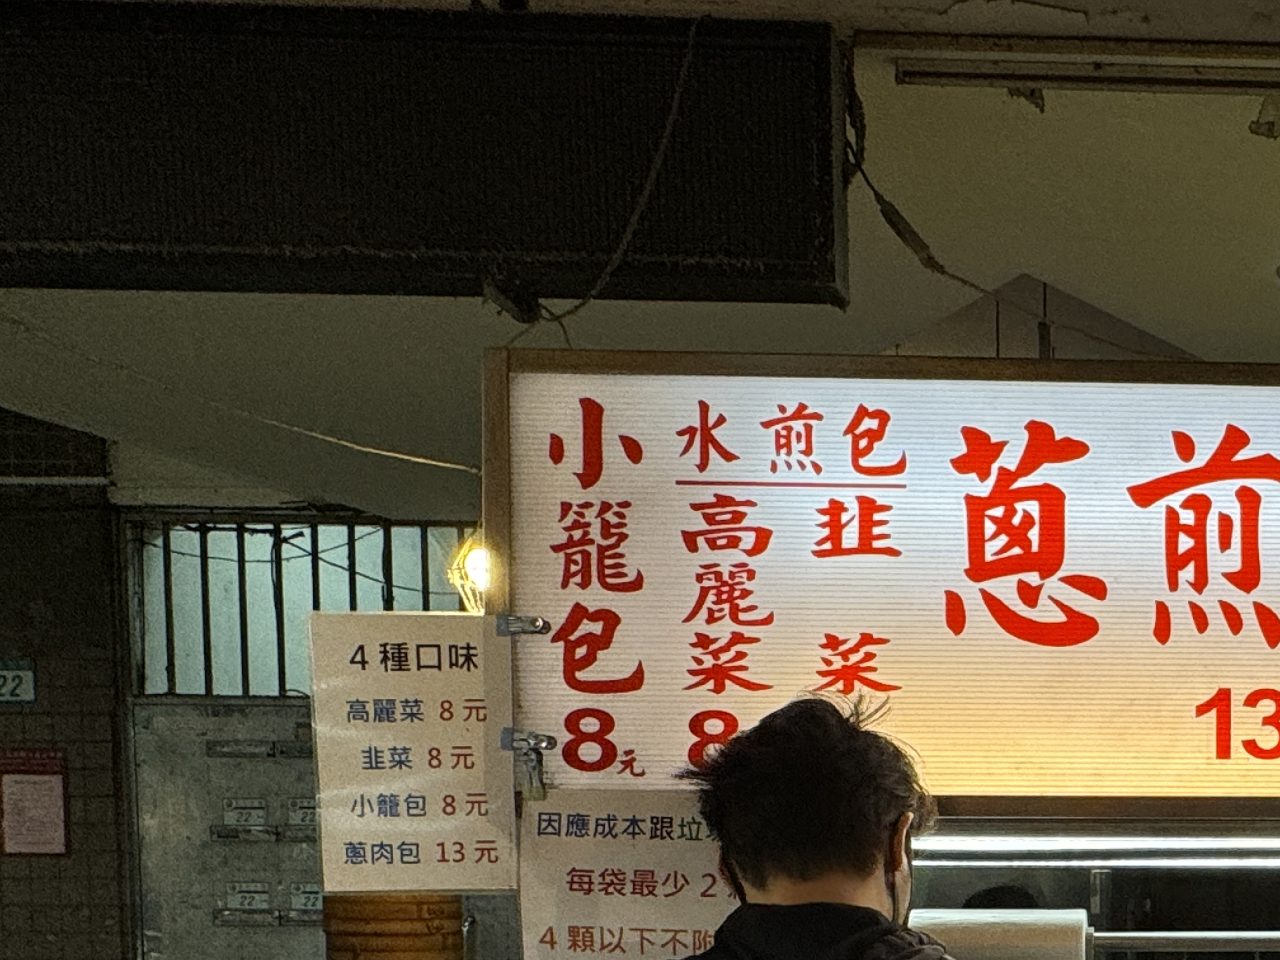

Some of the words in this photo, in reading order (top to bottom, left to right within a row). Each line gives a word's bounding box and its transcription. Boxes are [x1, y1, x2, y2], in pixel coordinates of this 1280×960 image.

[676, 400, 907, 478] 水煎包
[549, 397, 646, 695] 小籠包
[681, 493, 774, 695] 高麗菜
[811, 496, 903, 695] 韭菜
[537, 812, 721, 842] 因應成本跟垃
